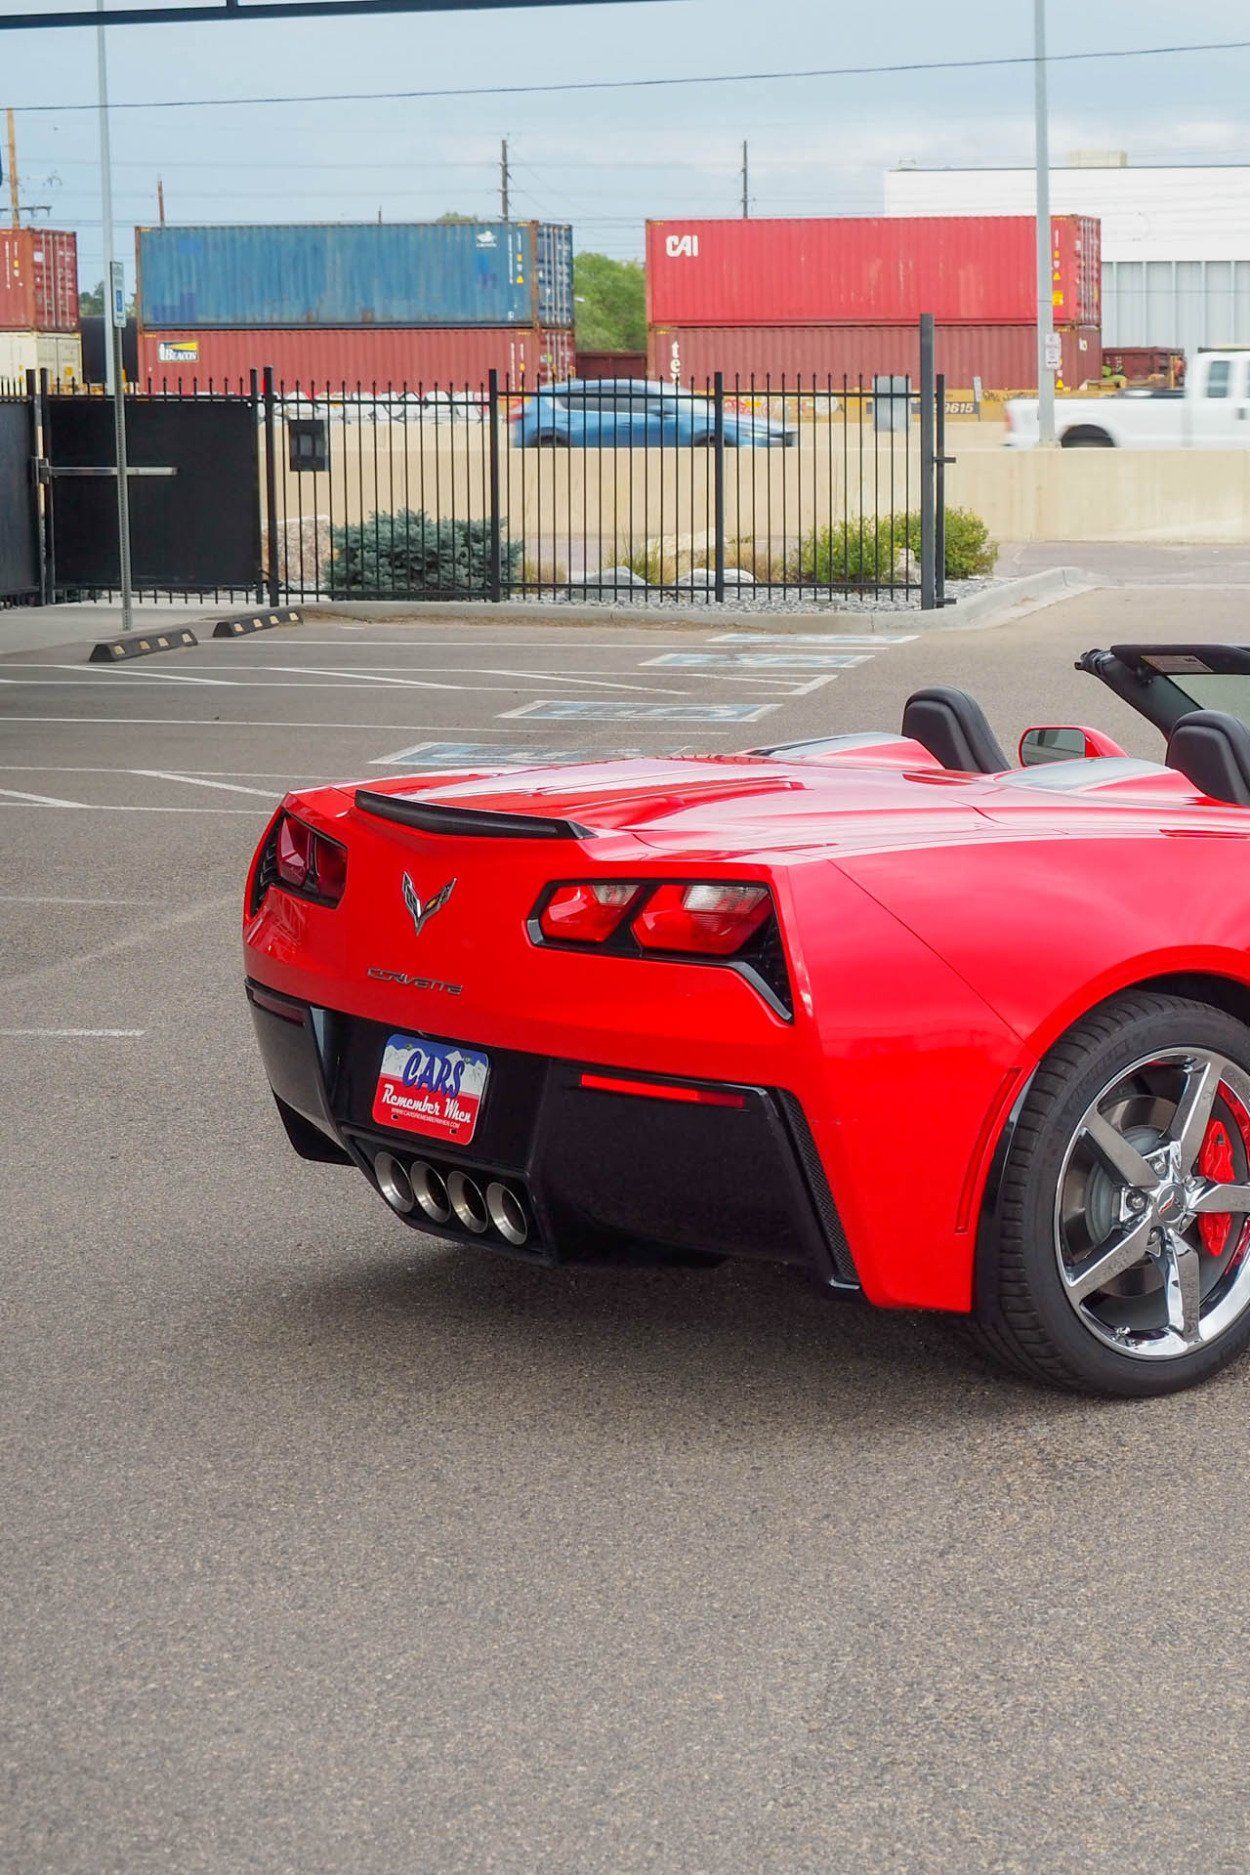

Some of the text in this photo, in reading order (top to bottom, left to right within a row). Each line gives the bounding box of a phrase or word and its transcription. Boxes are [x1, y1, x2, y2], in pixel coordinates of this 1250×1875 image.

[665, 235, 699, 257] CAI
[368, 967, 463, 995] CORVETTE
[402, 1050, 465, 1098] CARS
[382, 1083, 471, 1123] Remember When
